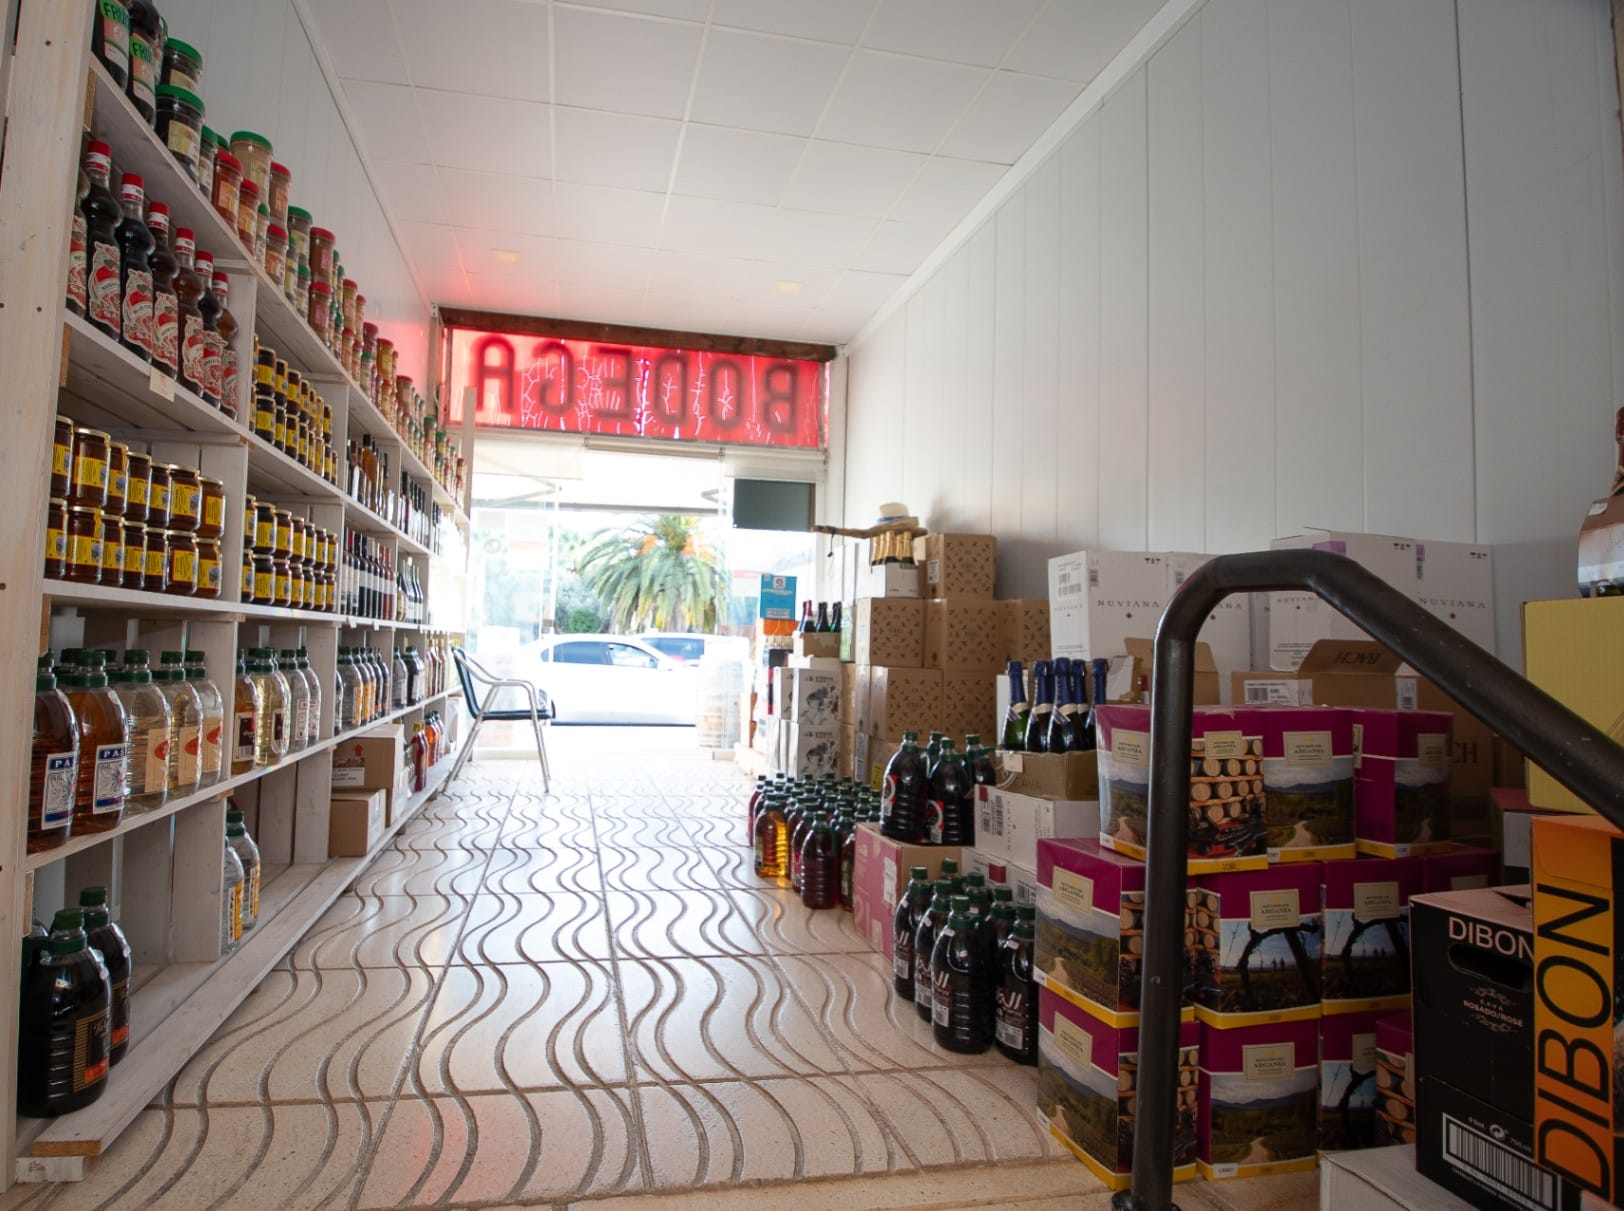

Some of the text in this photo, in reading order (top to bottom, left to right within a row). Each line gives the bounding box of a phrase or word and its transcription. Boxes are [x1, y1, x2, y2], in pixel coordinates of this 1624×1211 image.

[1097, 600, 1160, 608] NUVIANA
[1419, 597, 1486, 609] NUVIANA
[1536, 883, 1612, 1202] DIBON
